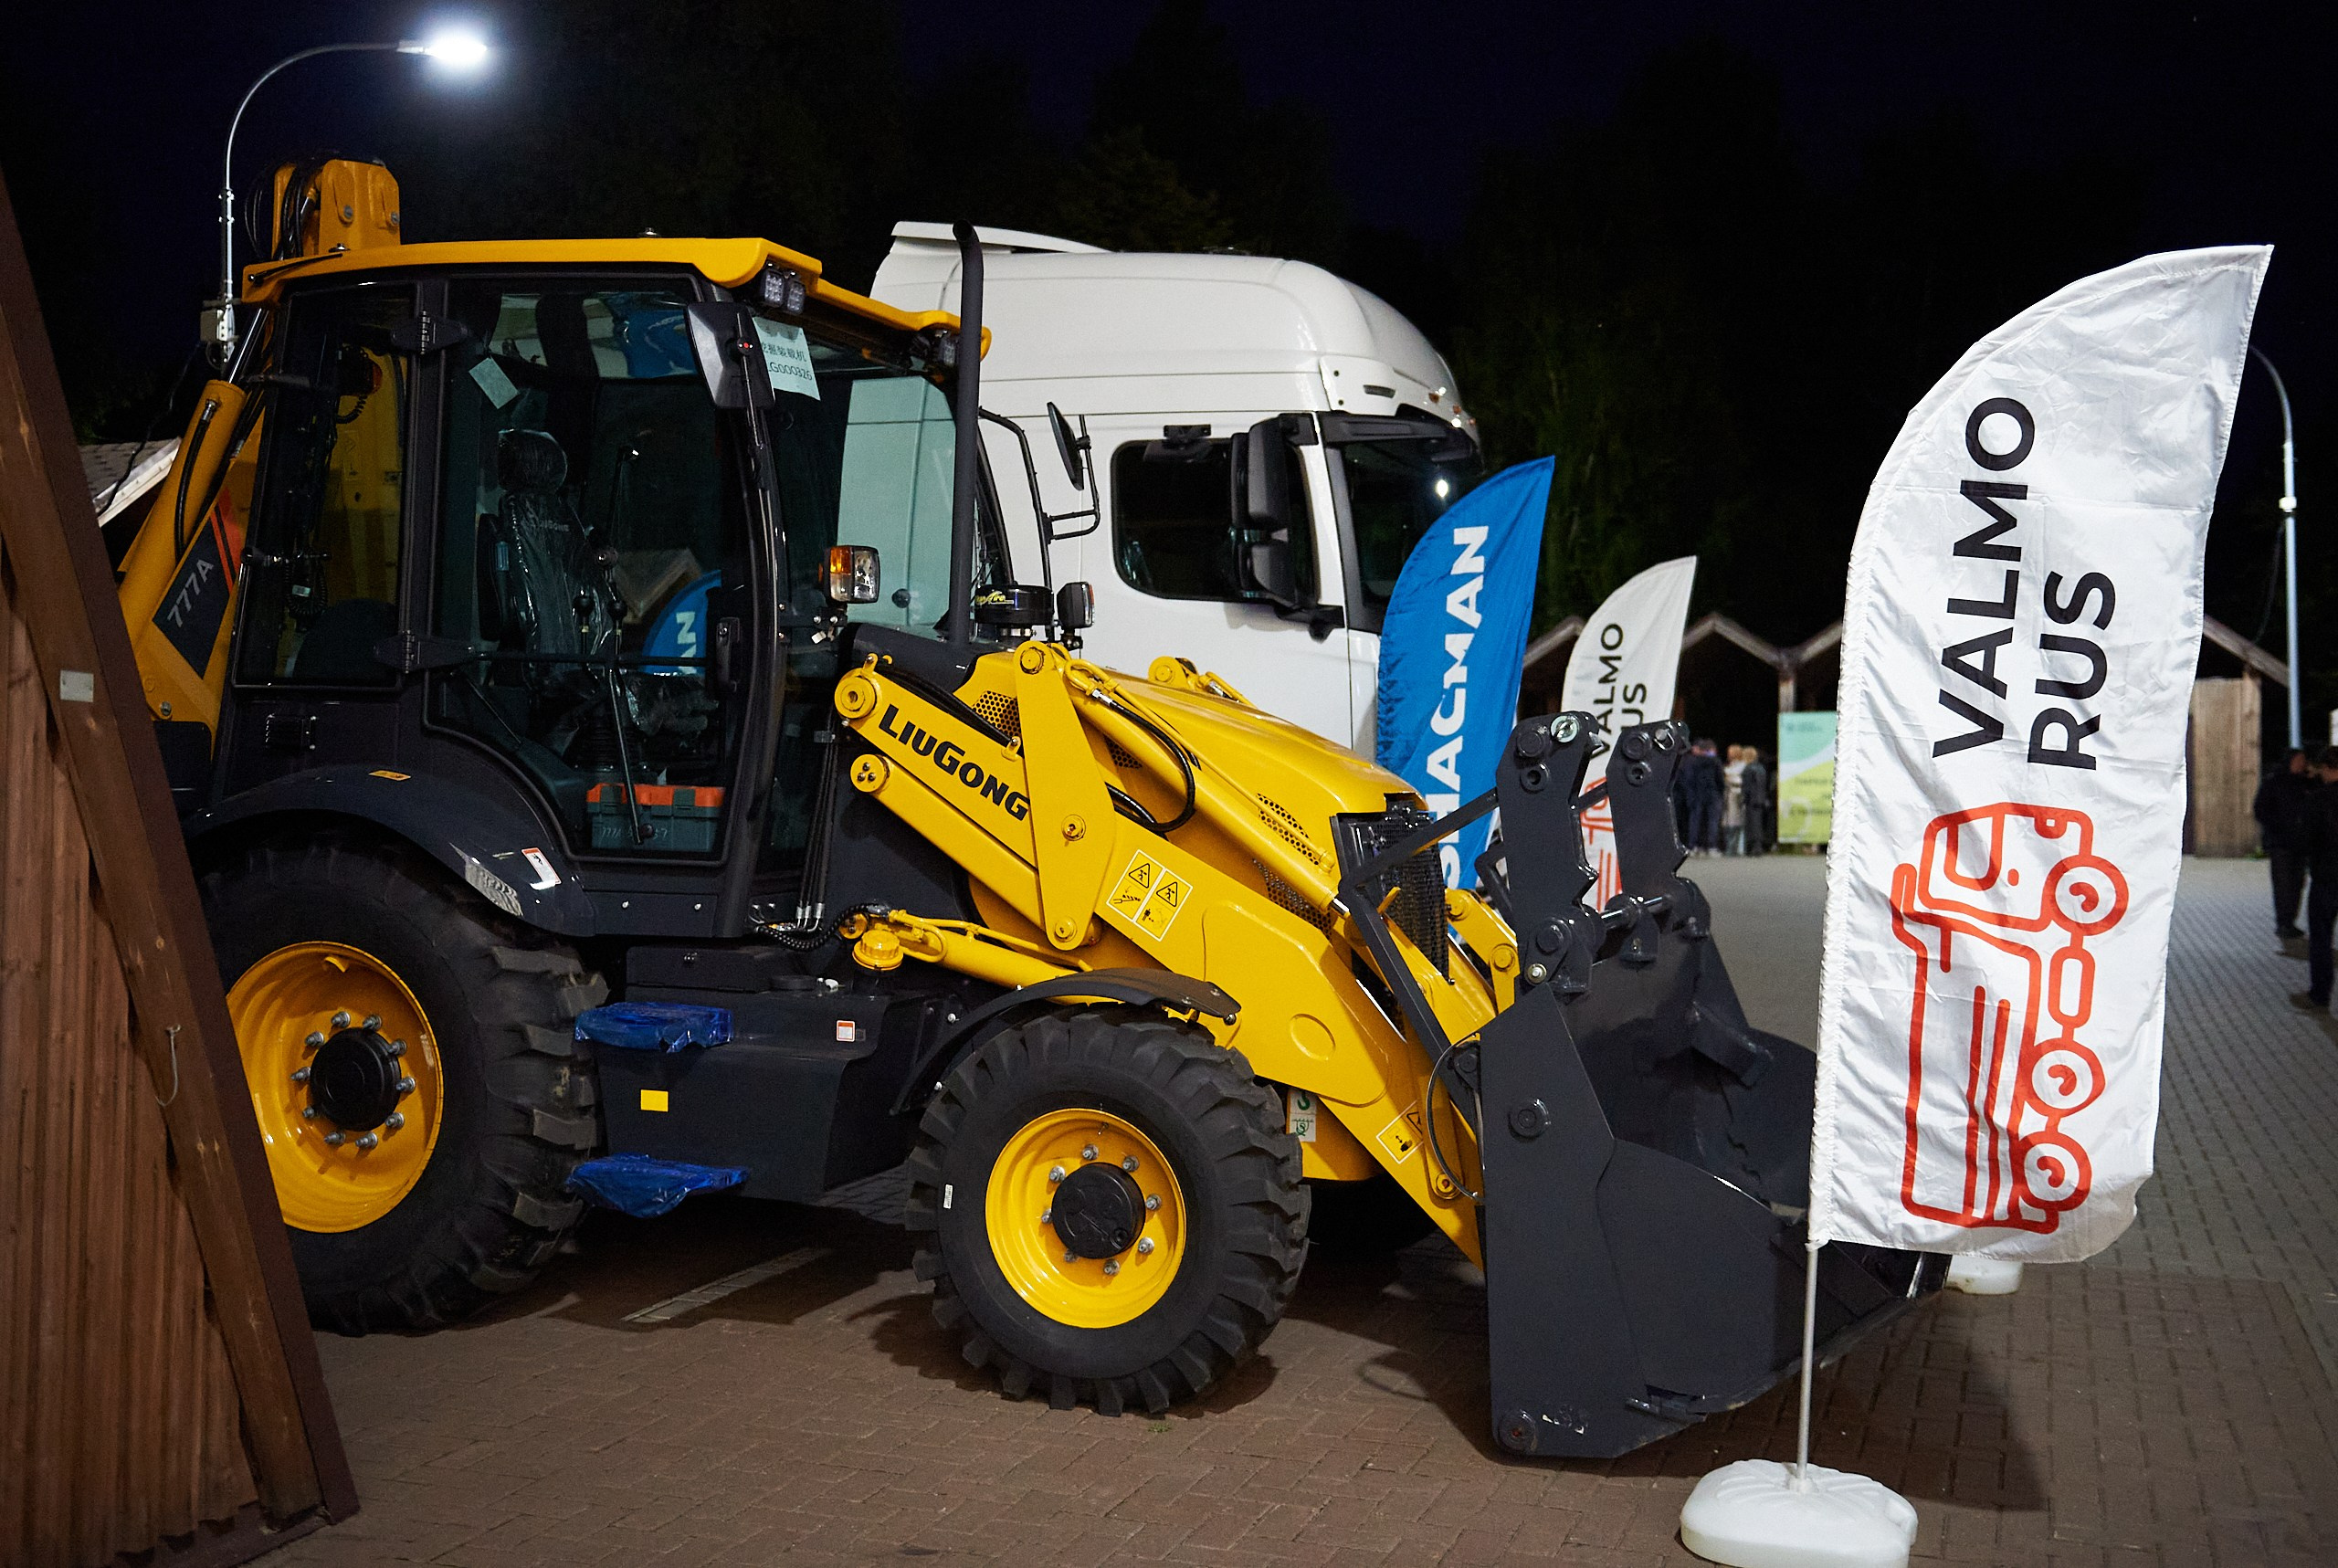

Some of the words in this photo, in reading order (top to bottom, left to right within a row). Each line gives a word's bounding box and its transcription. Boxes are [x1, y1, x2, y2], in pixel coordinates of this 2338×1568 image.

[768, 362, 813, 381] G000326
[167, 560, 215, 628] 777A
[1933, 396, 2035, 758] VALMO
[1590, 624, 1624, 760] VALMO
[1621, 683, 1647, 731] US
[2027, 571, 2115, 771] RUS
